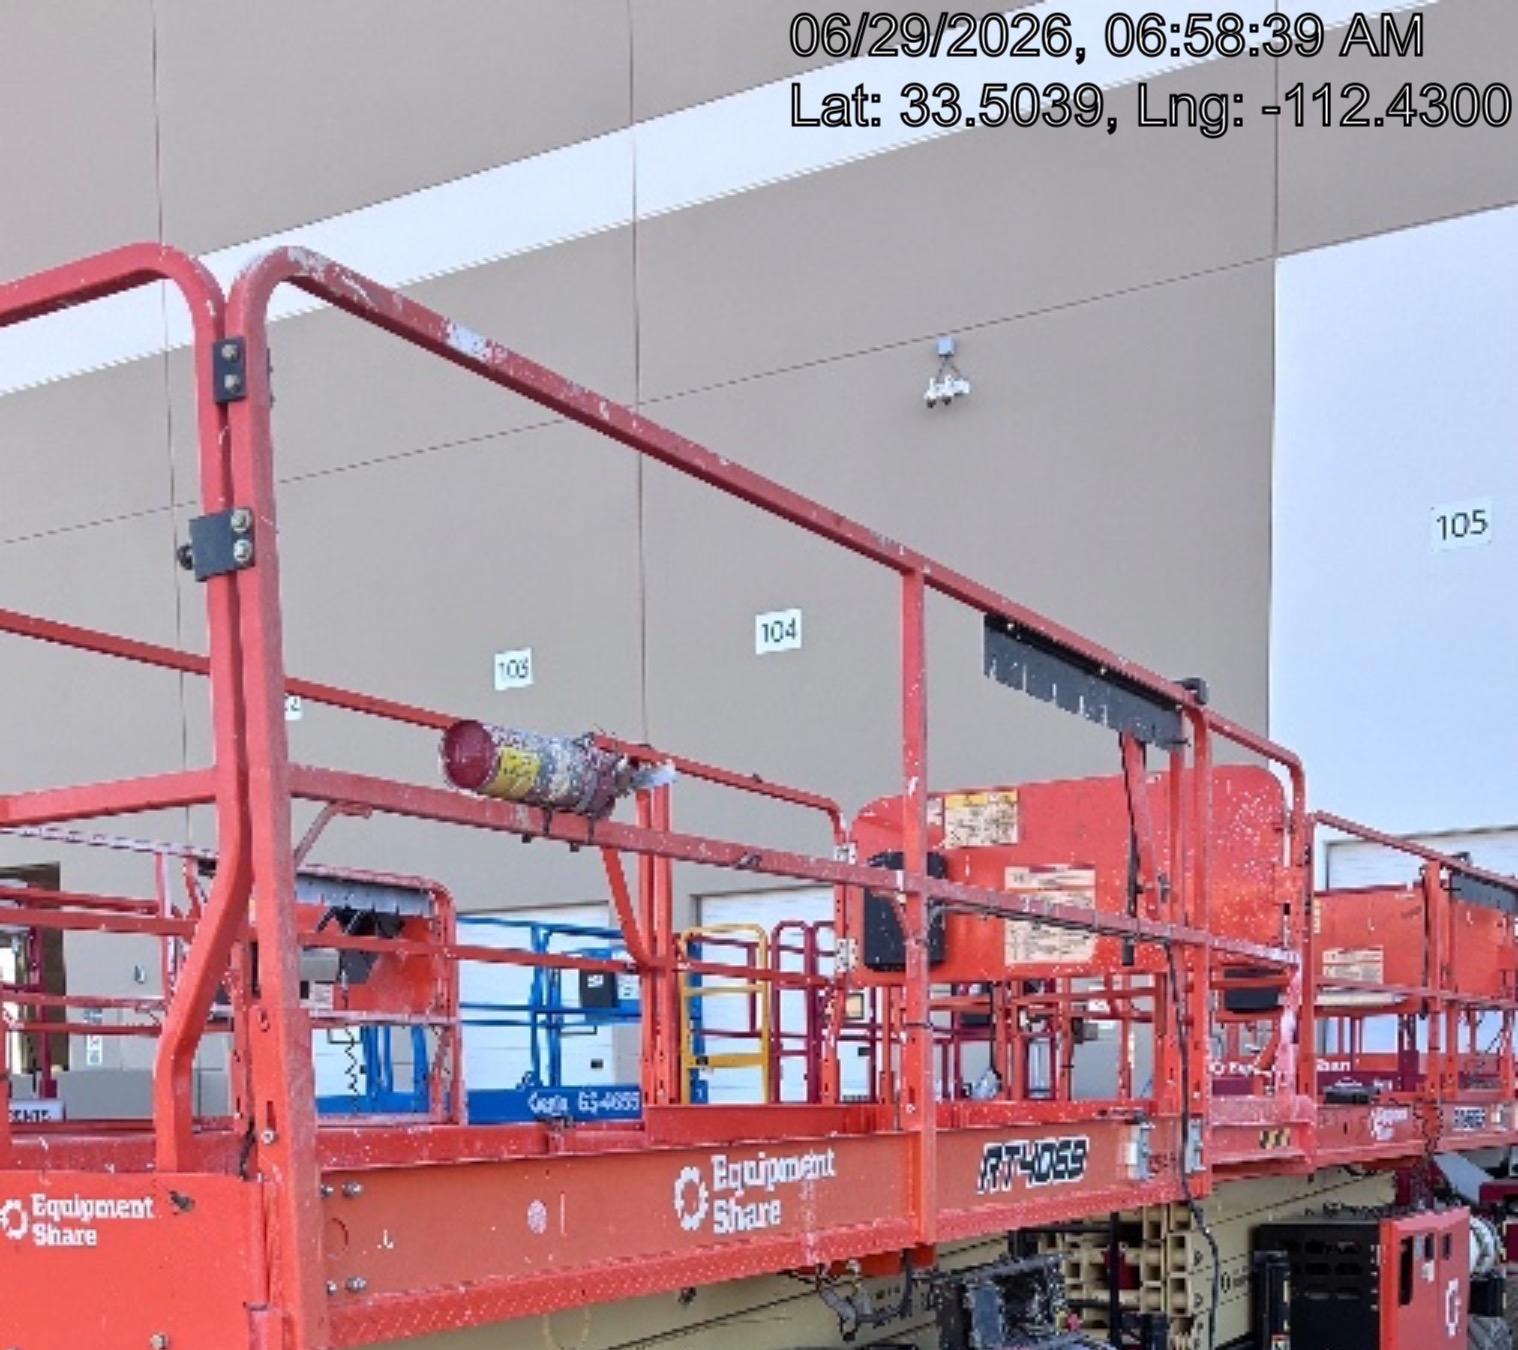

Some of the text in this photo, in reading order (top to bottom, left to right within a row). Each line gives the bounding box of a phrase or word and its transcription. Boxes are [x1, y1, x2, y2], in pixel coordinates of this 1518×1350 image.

[1436, 508, 1489, 541] 105
[761, 617, 796, 643] 104
[711, 1148, 836, 1197] Equipment
[30, 1193, 155, 1222] Equipment
[713, 1197, 781, 1234] Share
[32, 1223, 97, 1246] Share
